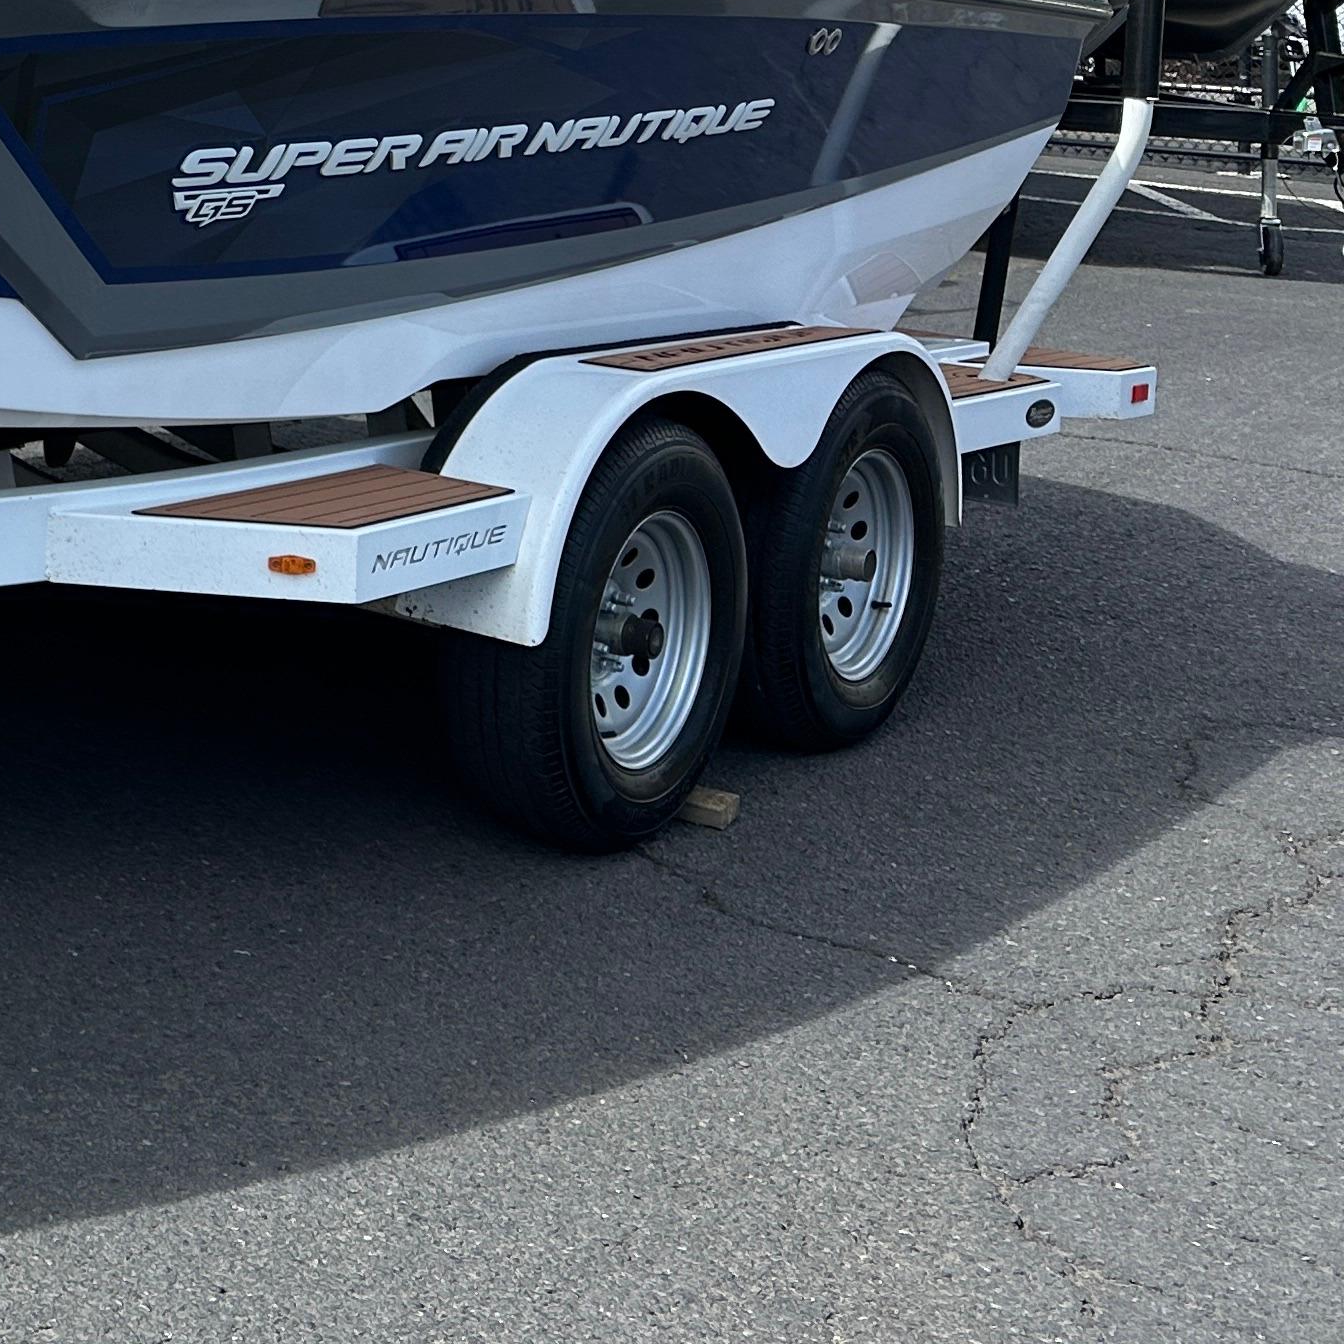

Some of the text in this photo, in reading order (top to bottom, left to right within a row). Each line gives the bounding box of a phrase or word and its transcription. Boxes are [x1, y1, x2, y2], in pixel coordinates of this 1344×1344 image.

[171, 97, 776, 188] SUPER AIR NAUTIQUE
[189, 189, 258, 227] GS
[371, 524, 508, 574] NAUTIQUE
